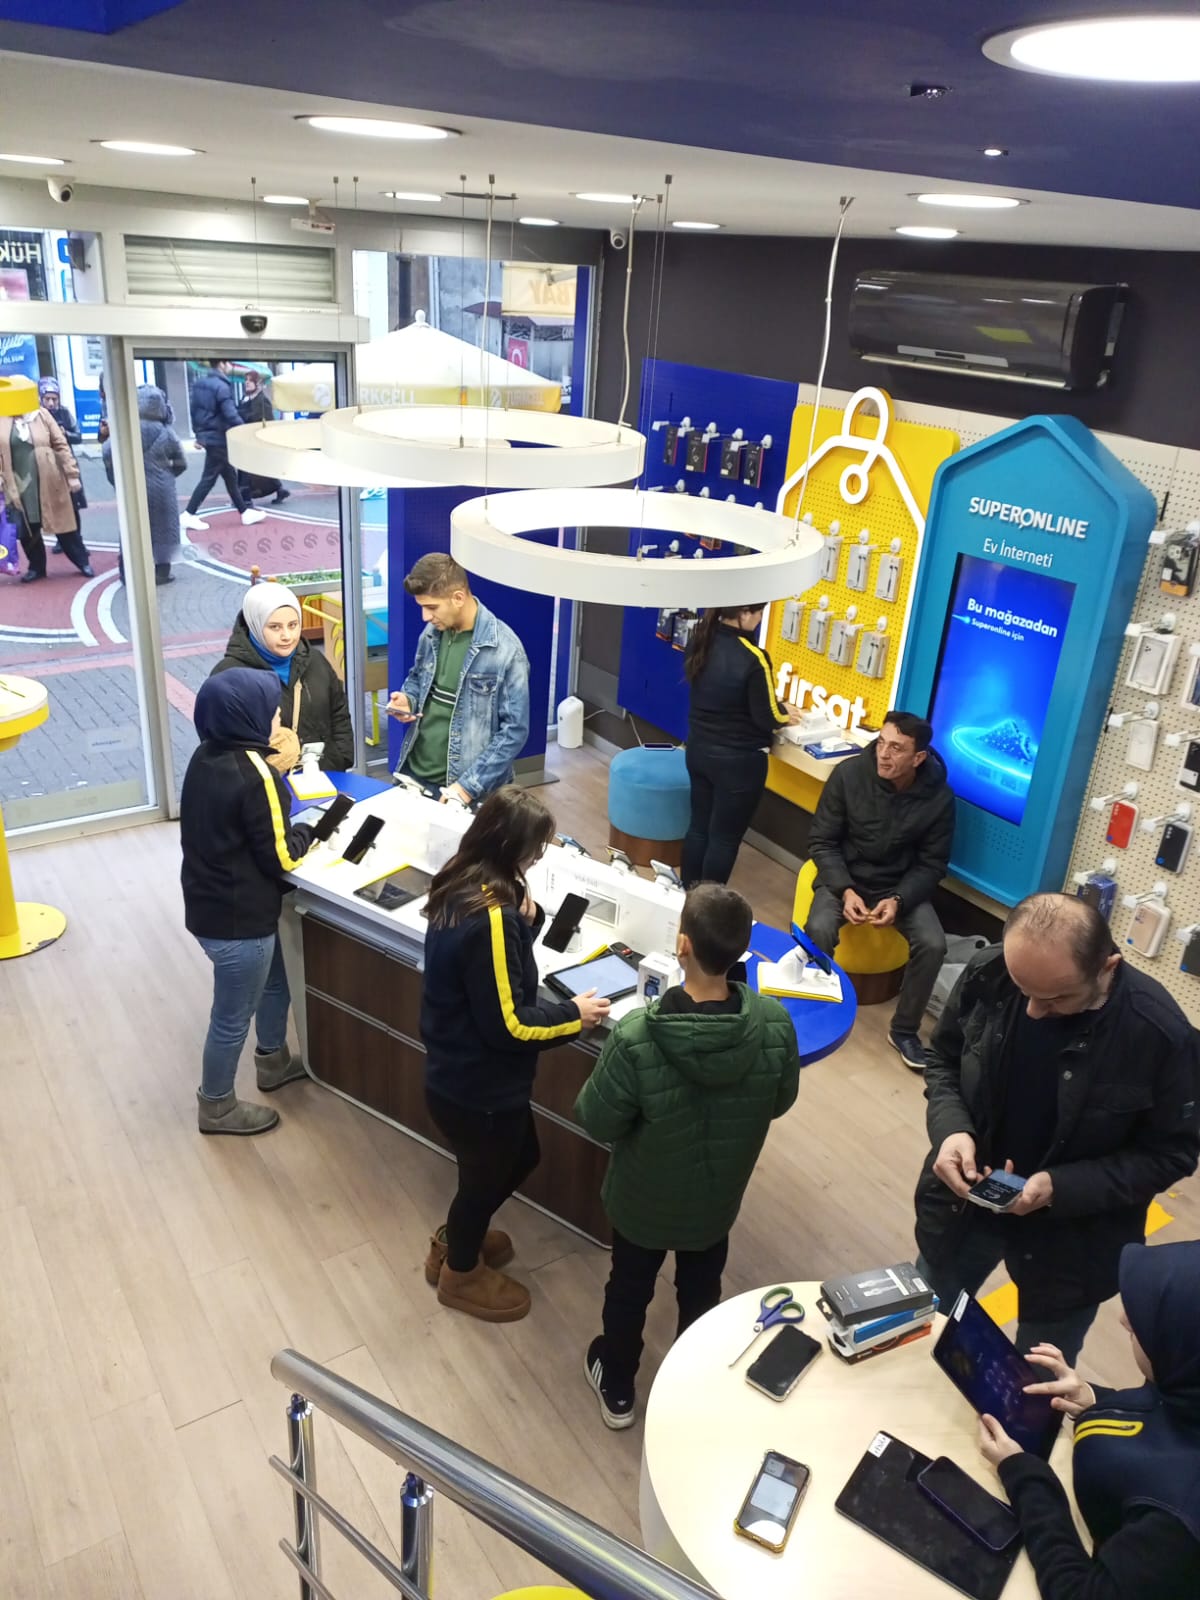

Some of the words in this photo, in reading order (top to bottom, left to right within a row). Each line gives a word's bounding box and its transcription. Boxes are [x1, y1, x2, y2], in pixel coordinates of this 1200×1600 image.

[359, 386, 416, 405] RKCELL
[968, 496, 1089, 539] SUPERONLINE
[983, 537, 999, 554] Ev
[1000, 539, 1054, 568] İnterneti
[967, 597, 983, 614] Bu
[984, 606, 1058, 638] mağazadan
[971, 617, 1011, 637] Superonline
[775, 661, 867, 734] fırsat
